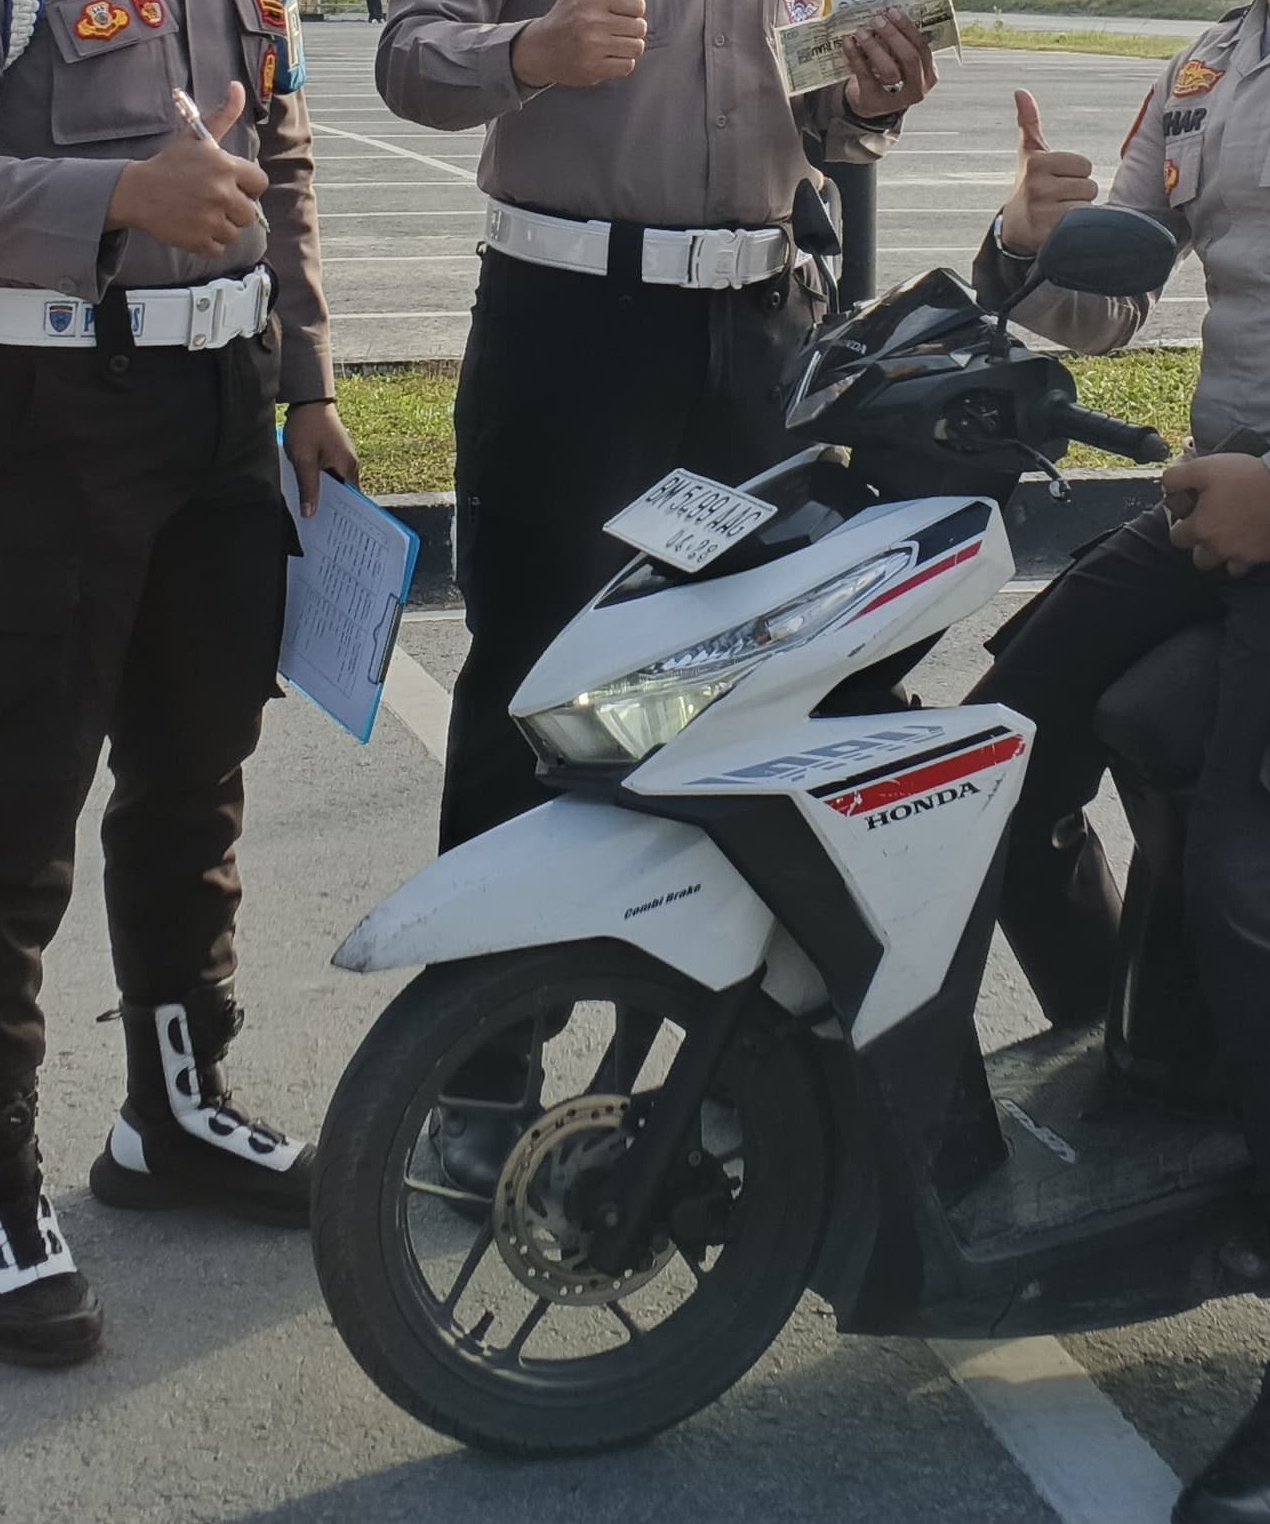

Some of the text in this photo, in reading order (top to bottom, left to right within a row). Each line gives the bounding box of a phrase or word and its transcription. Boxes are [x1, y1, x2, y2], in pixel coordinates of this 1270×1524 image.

[645, 476, 692, 509] BM
[706, 503, 762, 538] AAG
[864, 781, 981, 831] HONDA
[624, 883, 702, 921] Combi Brake
